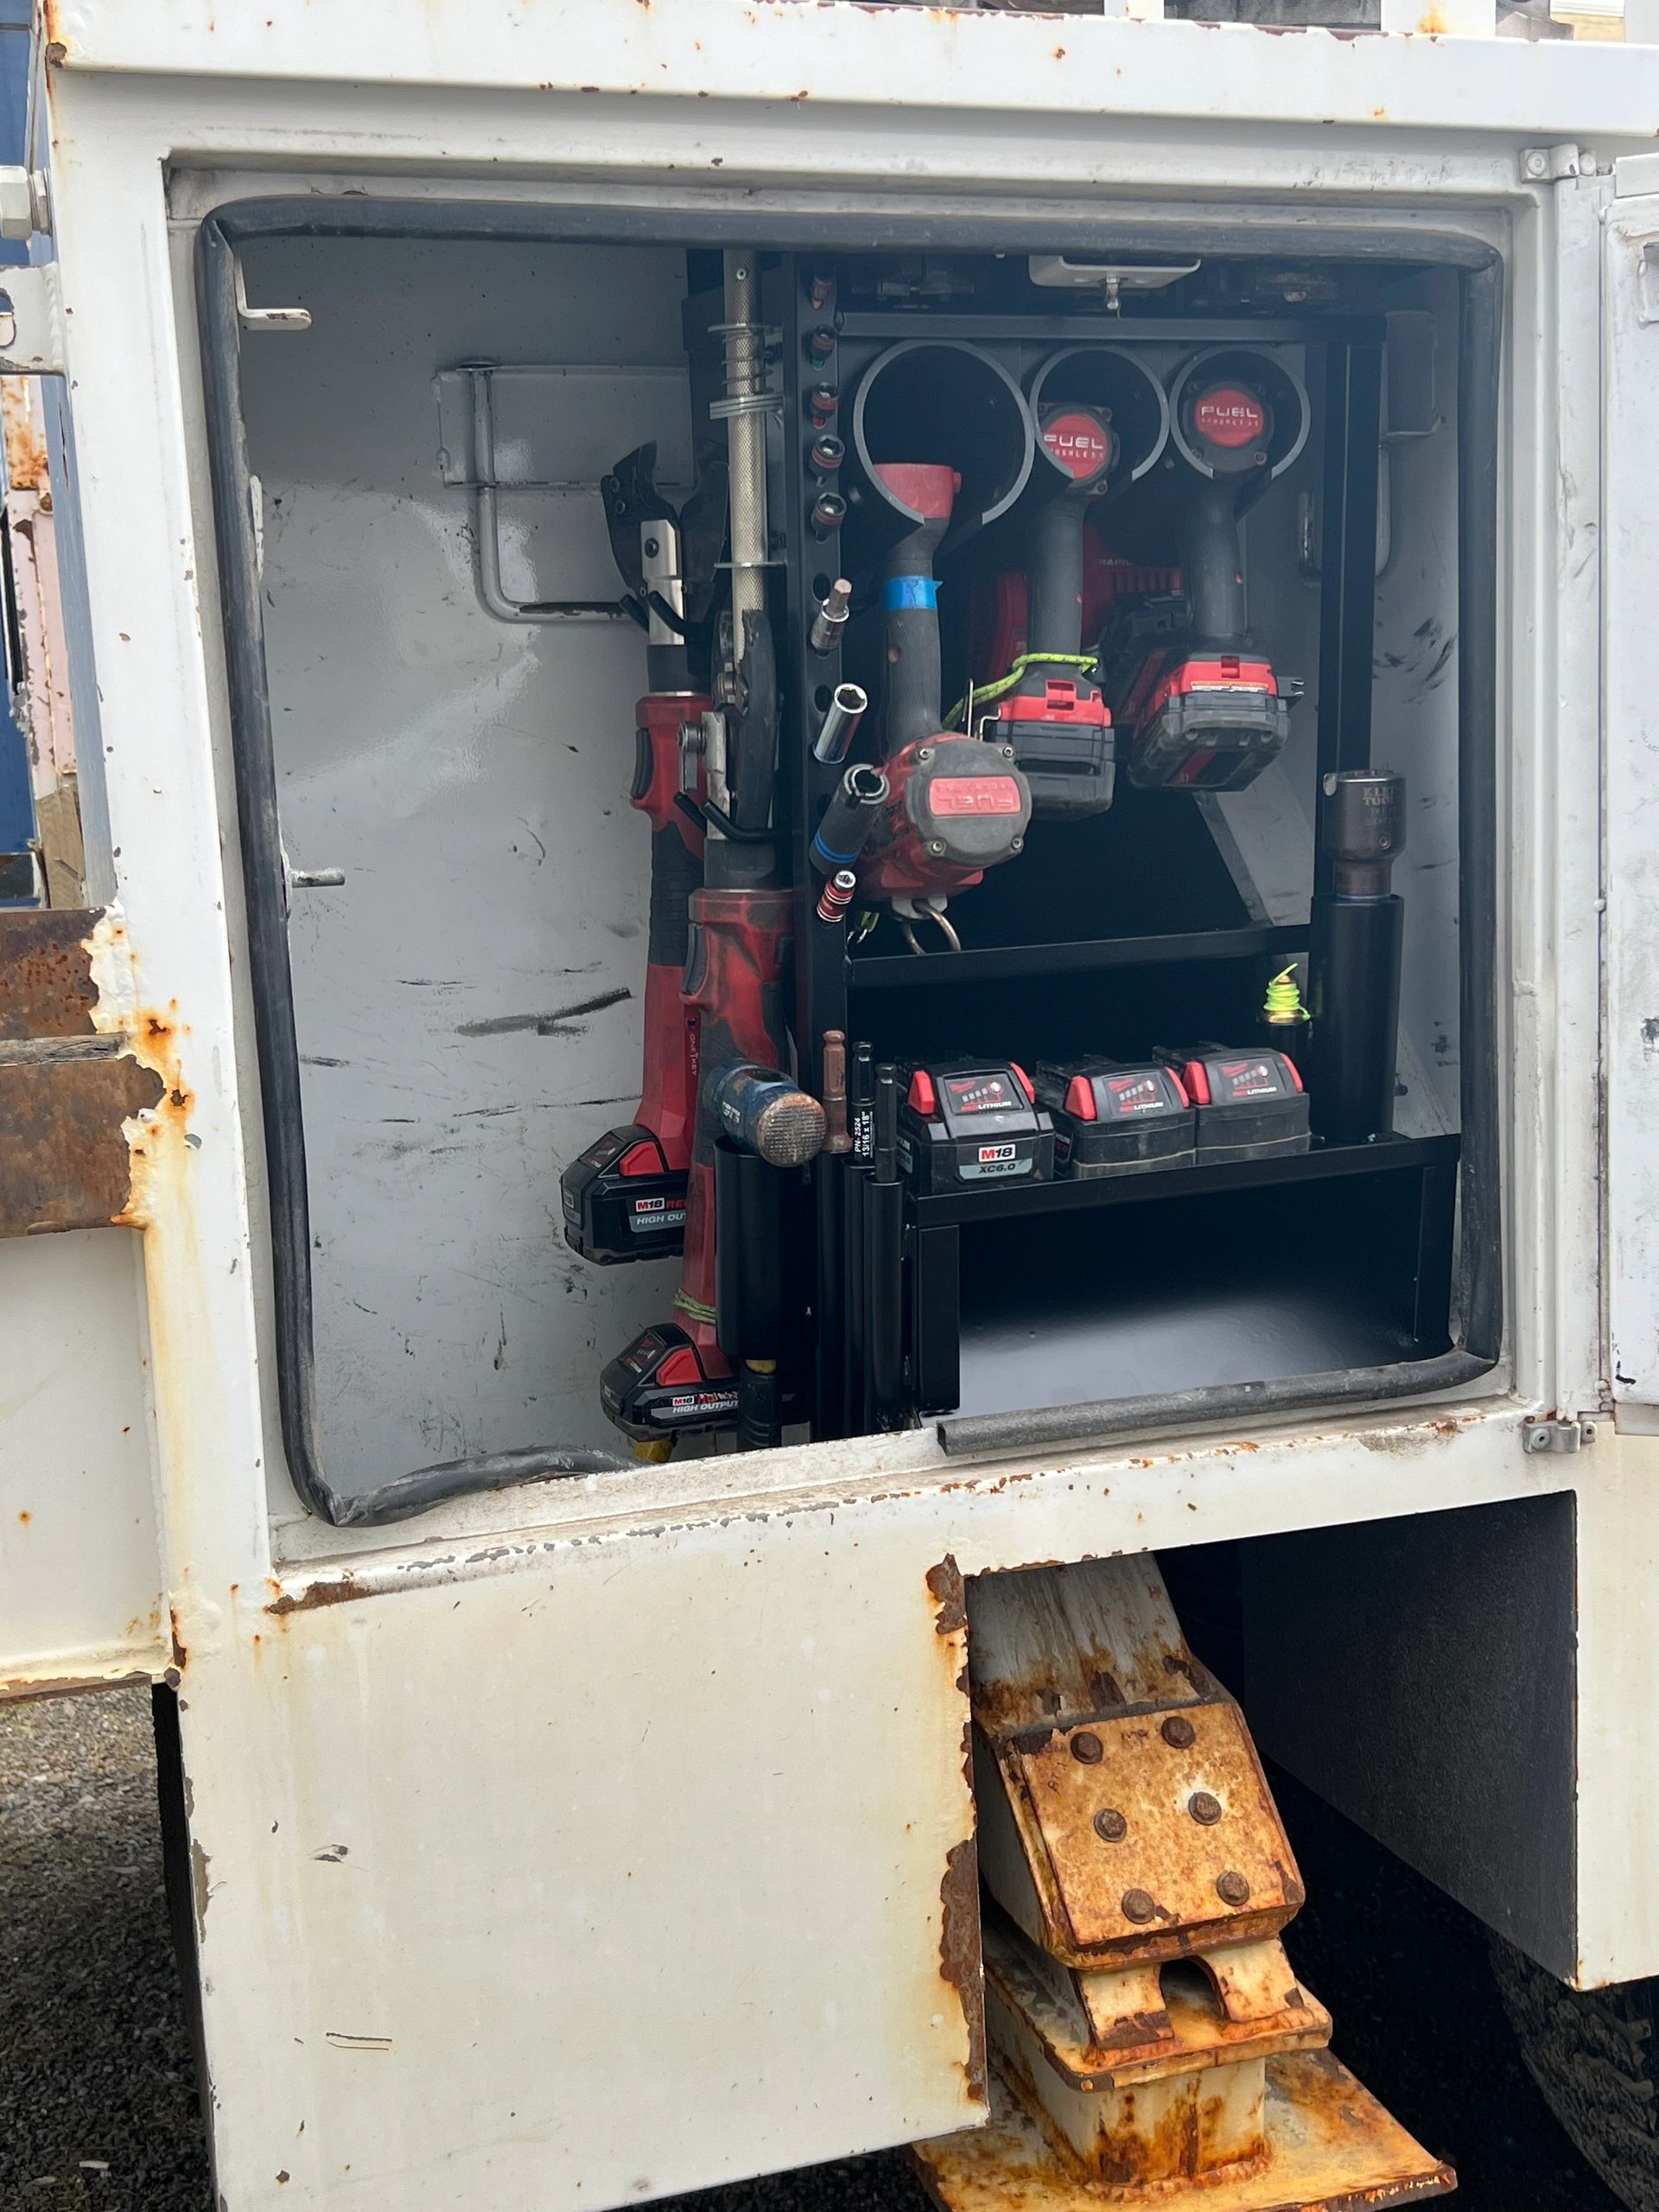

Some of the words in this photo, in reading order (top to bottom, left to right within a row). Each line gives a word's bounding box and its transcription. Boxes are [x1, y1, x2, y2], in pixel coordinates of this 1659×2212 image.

[1201, 406, 1258, 418] FUEL
[1044, 435, 1103, 449] FUEL
[981, 1147, 1013, 1160] M18
[978, 1163, 1016, 1174] XC6.0
[638, 1200, 664, 1211] M18
[637, 1215, 664, 1225] HIGH
[674, 1396, 694, 1405] M18
[673, 1404, 698, 1414] HIGH
[701, 1400, 739, 1411] OUTPUT
